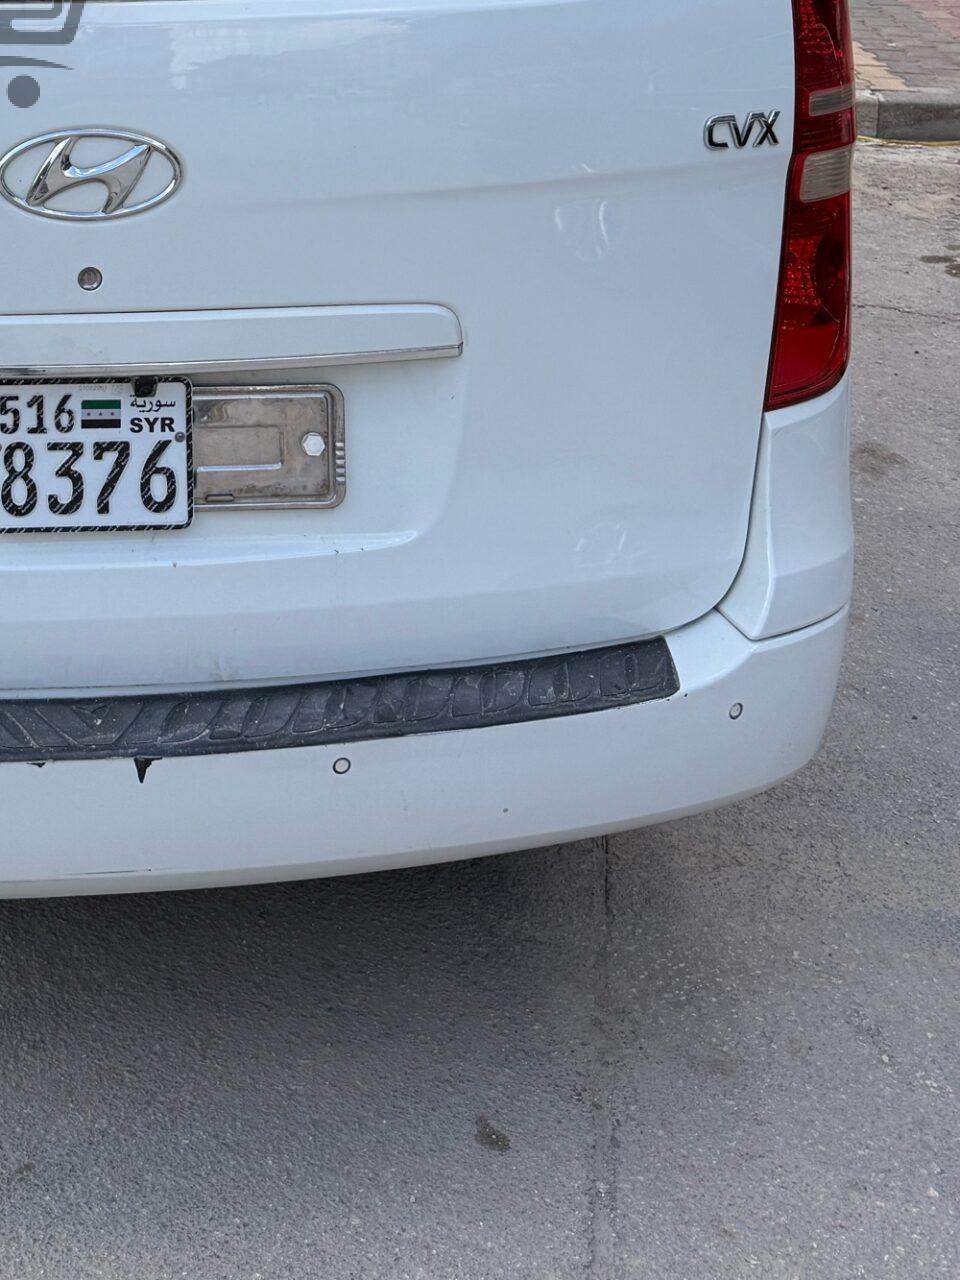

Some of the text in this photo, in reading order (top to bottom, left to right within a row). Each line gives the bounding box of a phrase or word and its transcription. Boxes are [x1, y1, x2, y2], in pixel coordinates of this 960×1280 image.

[703, 109, 781, 150] CVX
[129, 394, 176, 413] سورية
[129, 416, 176, 434] SYR
[1, 440, 177, 517] 8376
